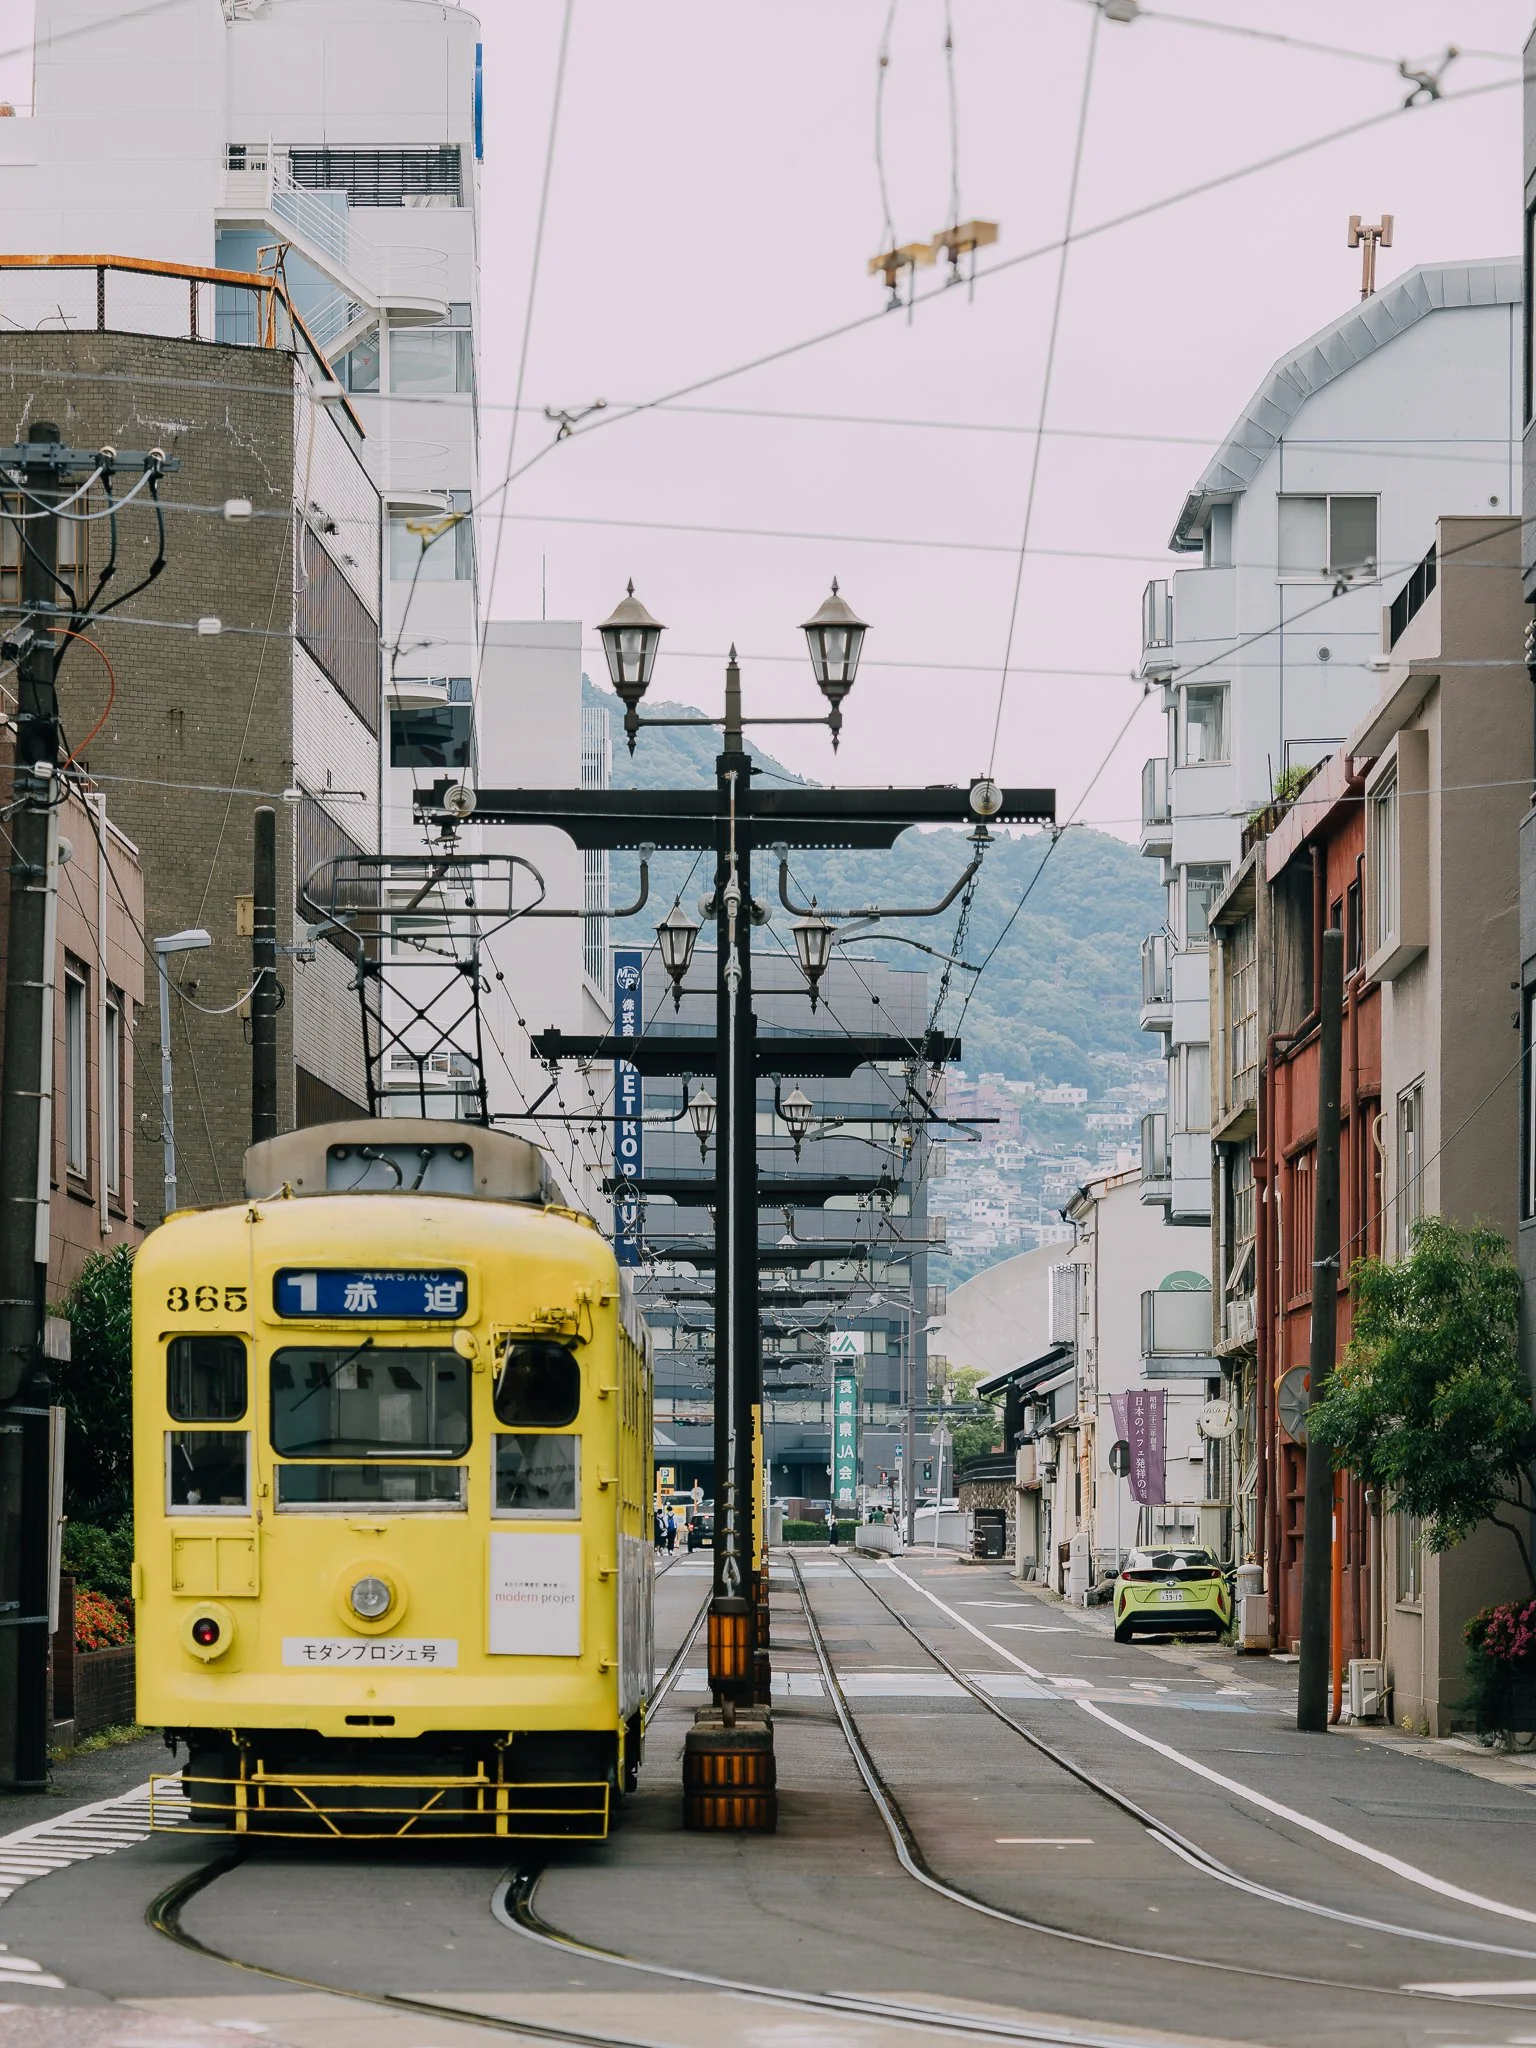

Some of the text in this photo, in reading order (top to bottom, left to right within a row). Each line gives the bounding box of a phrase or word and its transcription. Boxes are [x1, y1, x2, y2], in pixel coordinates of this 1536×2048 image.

[619, 998, 638, 1246] 株式会 METROPUS
[166, 1285, 248, 1313] 365
[287, 1273, 459, 1312] 1 赤迫
[837, 1379, 855, 1500] 長崎県JA会館
[495, 1591, 575, 1605] modern projet
[302, 1642, 438, 1663] モダンプロジェ号
